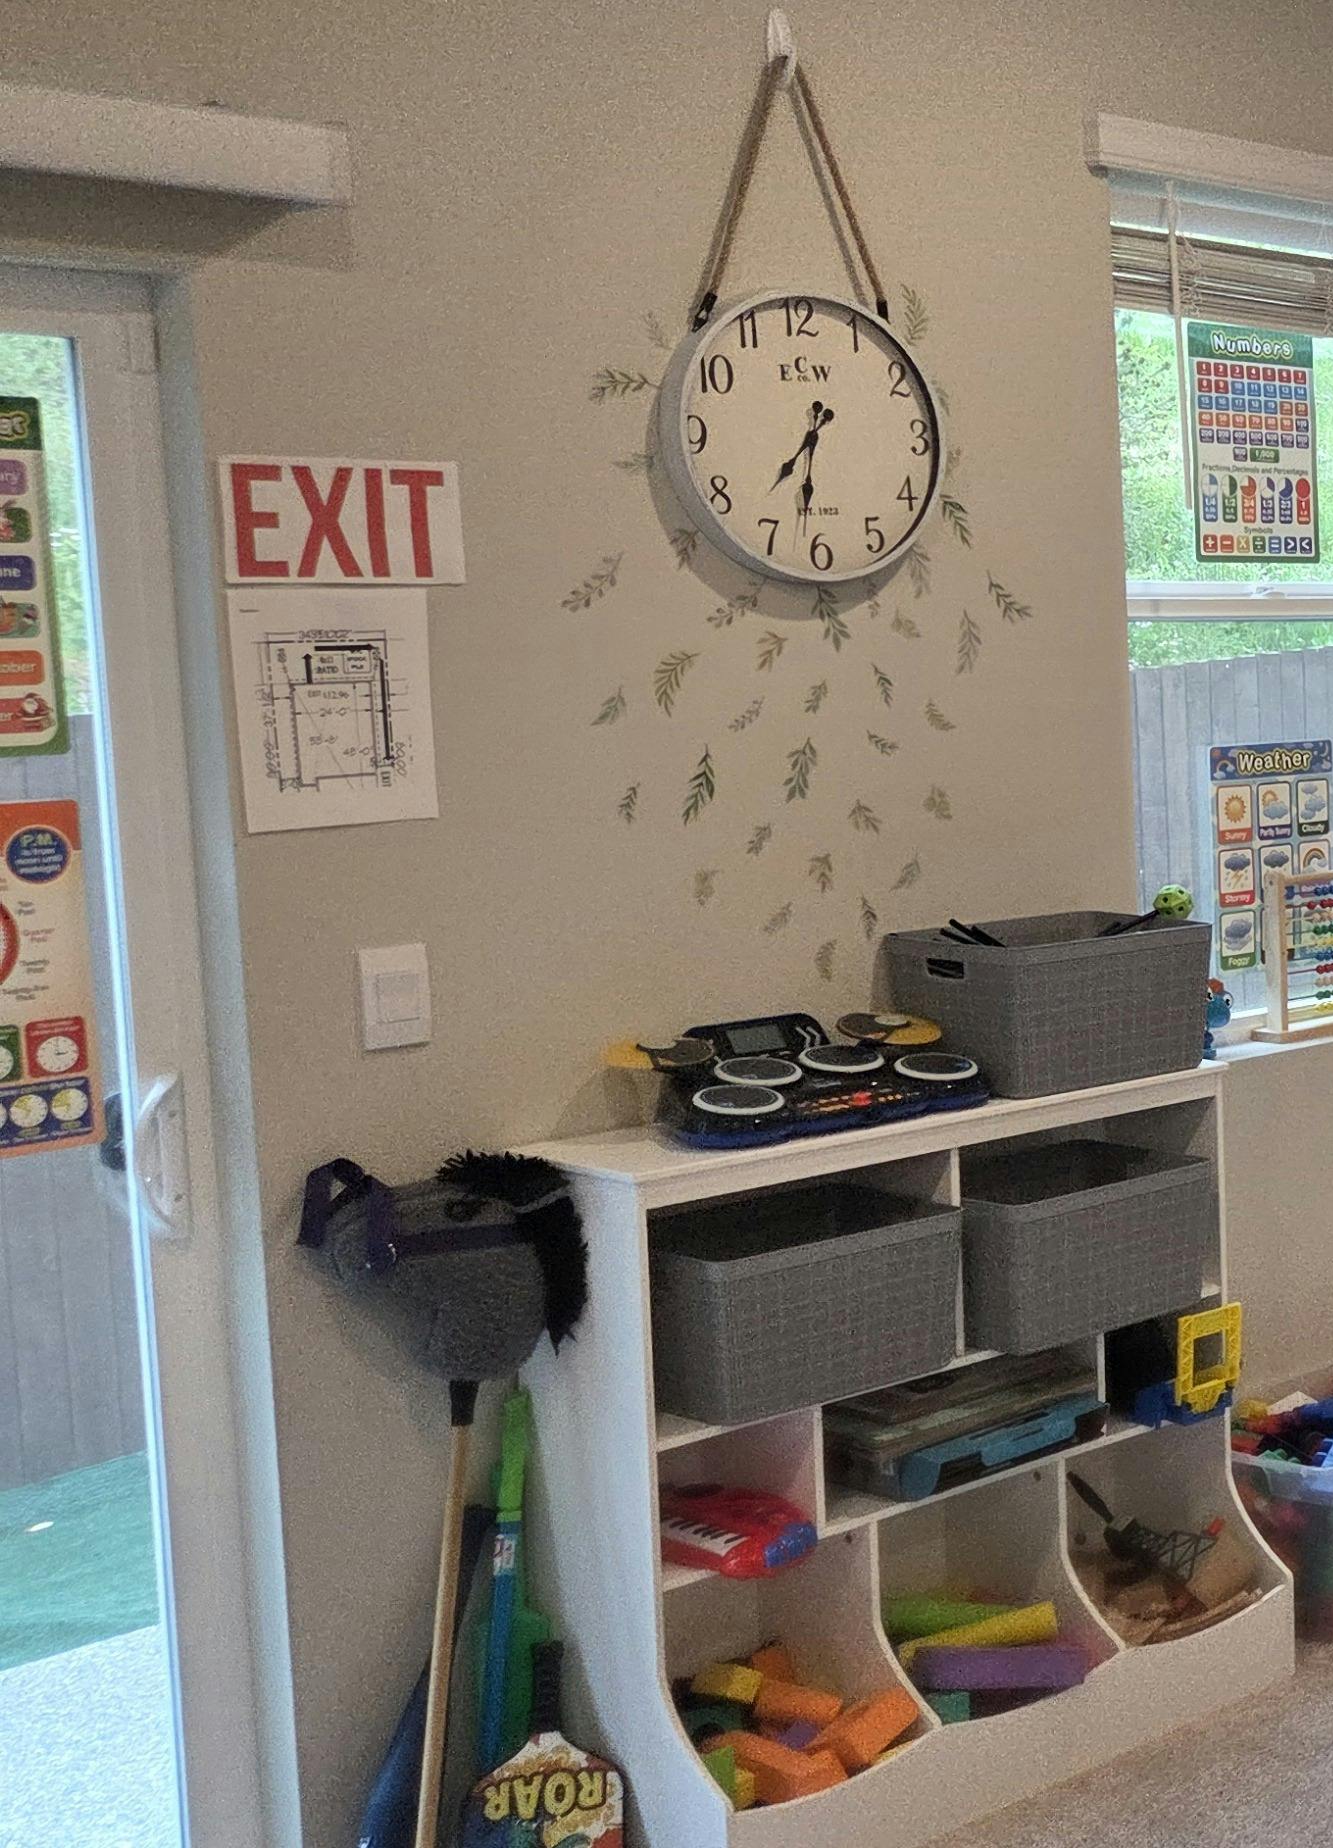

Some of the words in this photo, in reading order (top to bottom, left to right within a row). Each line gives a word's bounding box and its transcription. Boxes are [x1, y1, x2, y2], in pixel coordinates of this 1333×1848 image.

[736, 309, 759, 350] 11
[782, 298, 819, 338] 12
[845, 313, 860, 354] 1
[1212, 332, 1292, 358] Numbers
[699, 353, 734, 395] 10
[886, 359, 912, 399] 2
[686, 414, 708, 455] 9
[909, 418, 930, 456] 3
[708, 475, 733, 515] 8
[895, 474, 919, 513] 4
[229, 463, 444, 579] EXIT
[757, 517, 780, 556] 7
[863, 516, 885, 554] 5
[809, 531, 834, 572] 6
[1238, 749, 1311, 774] Weather
[1225, 831, 1248, 841] Sunny
[1301, 823, 1325, 834] Cloudy
[1225, 893, 1251, 904] Stormy
[1228, 956, 1251, 967] Foggy
[484, 1770, 606, 1822] ROAR
